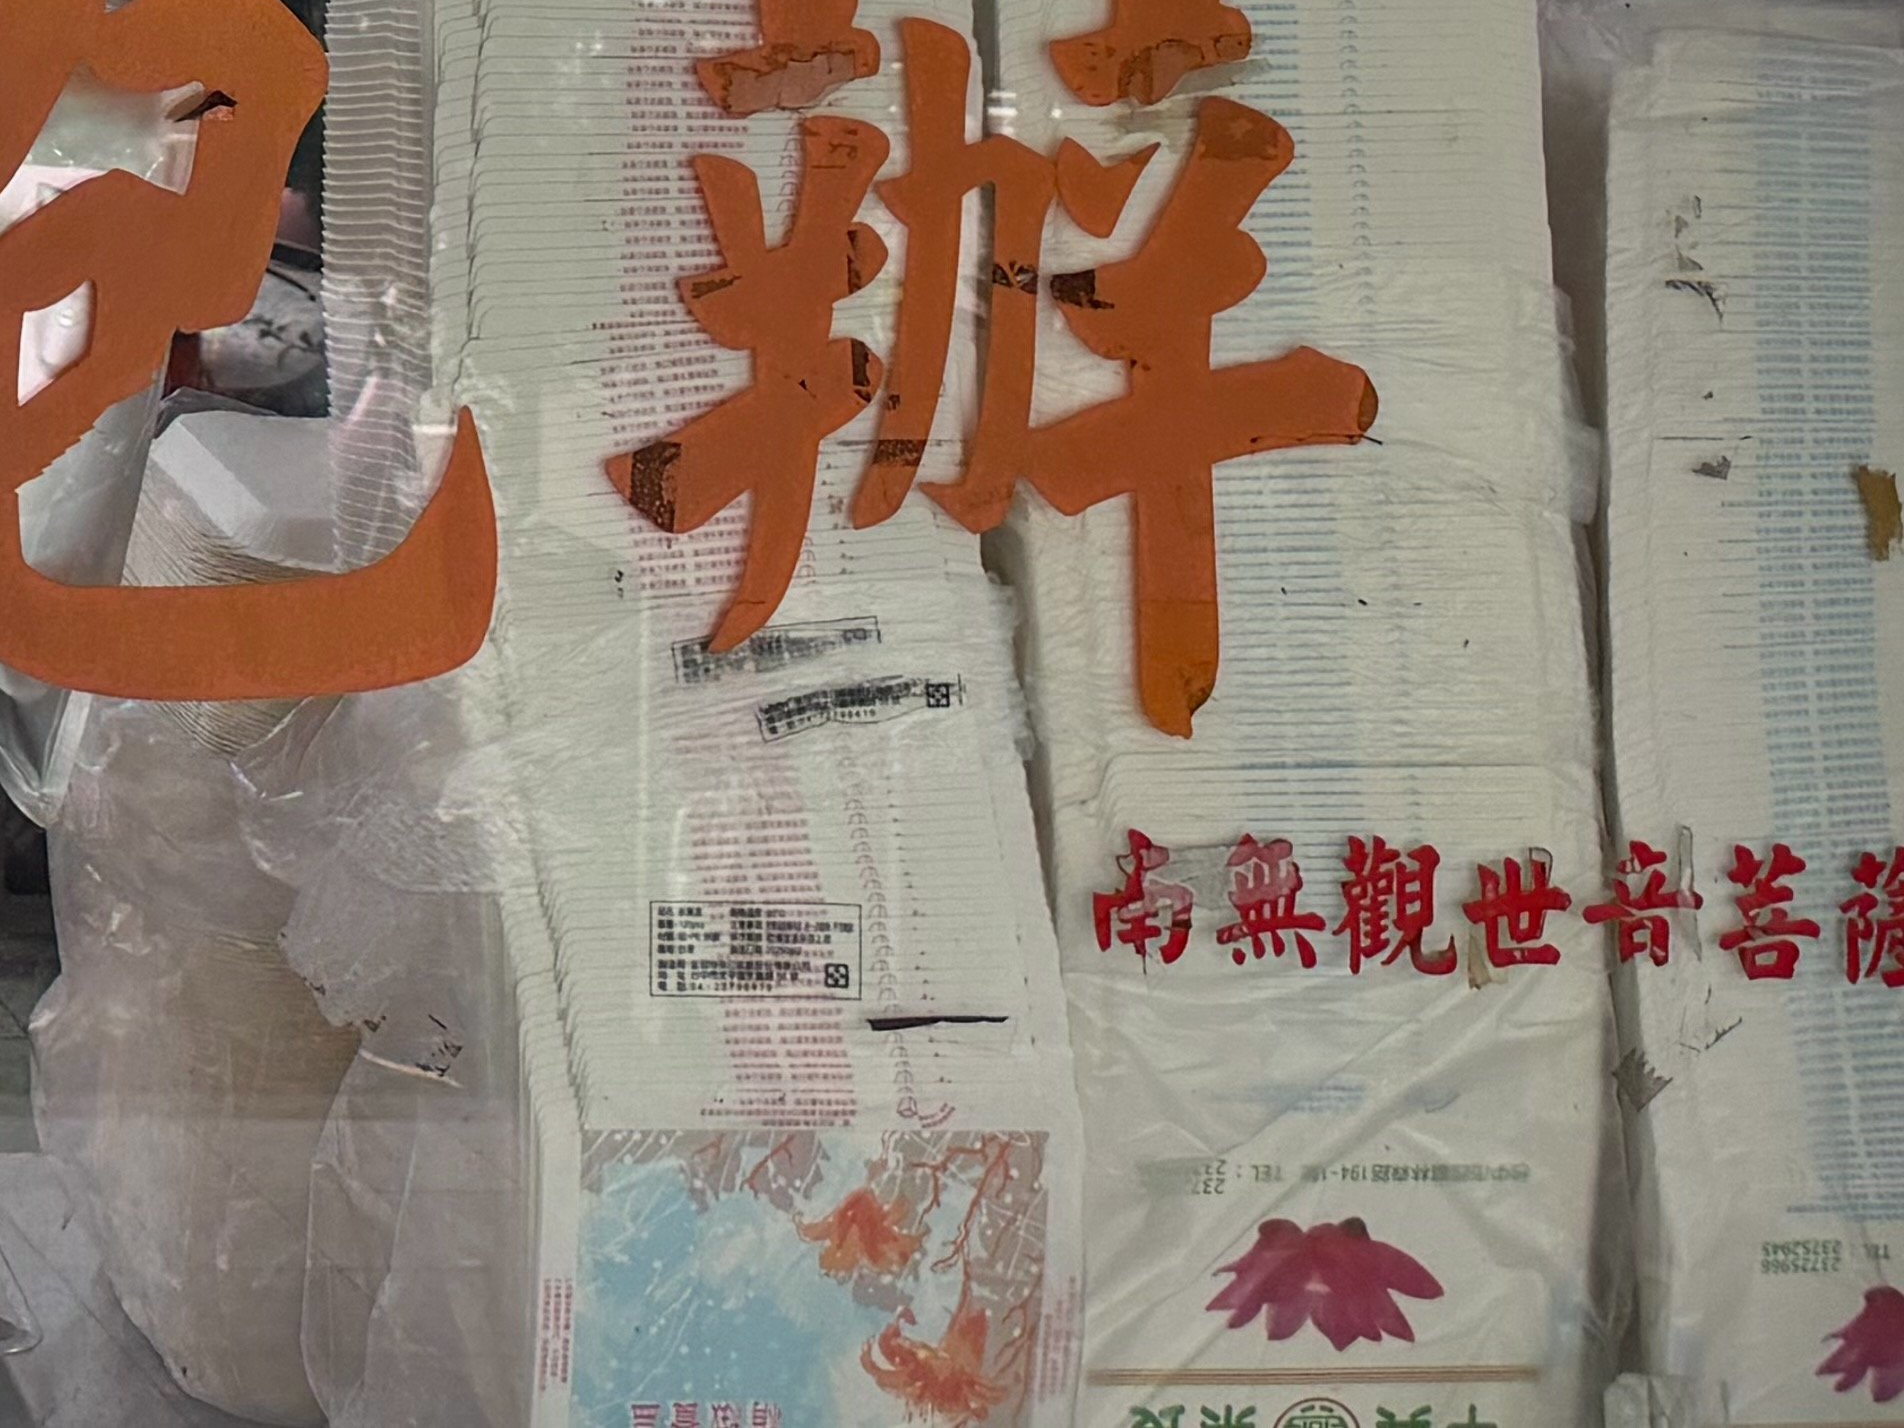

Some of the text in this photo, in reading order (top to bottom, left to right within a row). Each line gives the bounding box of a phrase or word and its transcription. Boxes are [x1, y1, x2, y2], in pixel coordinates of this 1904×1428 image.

[1093, 829, 1904, 990] 南無觀世音菩薩
